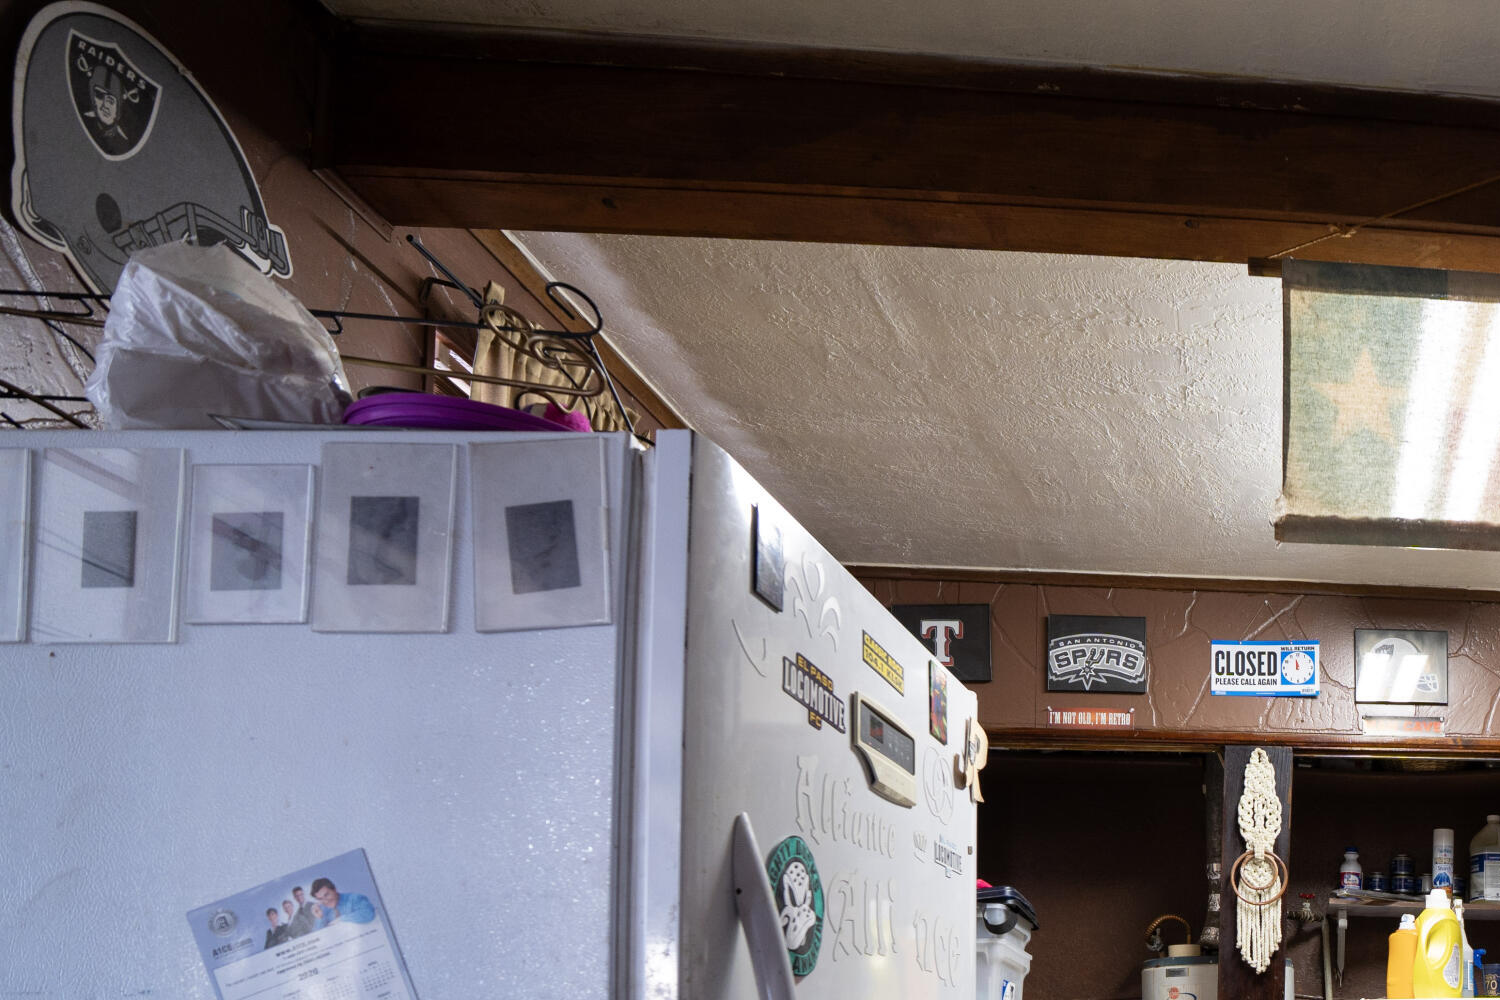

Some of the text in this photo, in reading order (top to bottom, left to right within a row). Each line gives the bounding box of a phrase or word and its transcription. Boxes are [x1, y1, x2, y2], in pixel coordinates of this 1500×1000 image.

[78, 40, 146, 90] RAIDERS
[920, 619, 964, 666] T
[1086, 638, 1136, 649] ANTONIO
[1055, 647, 1139, 671] SPURS
[1215, 650, 1278, 676] CLOSED
[809, 664, 833, 692] PASO
[1215, 678, 1239, 686] PLEASE
[1240, 678, 1256, 686] CALL
[784, 658, 845, 733] LOCOMOTIVE
[810, 711, 822, 728] FC
[1049, 711, 1131, 726] I'M NOT OLD, I'M RETRO
[1402, 720, 1442, 734] CAVE
